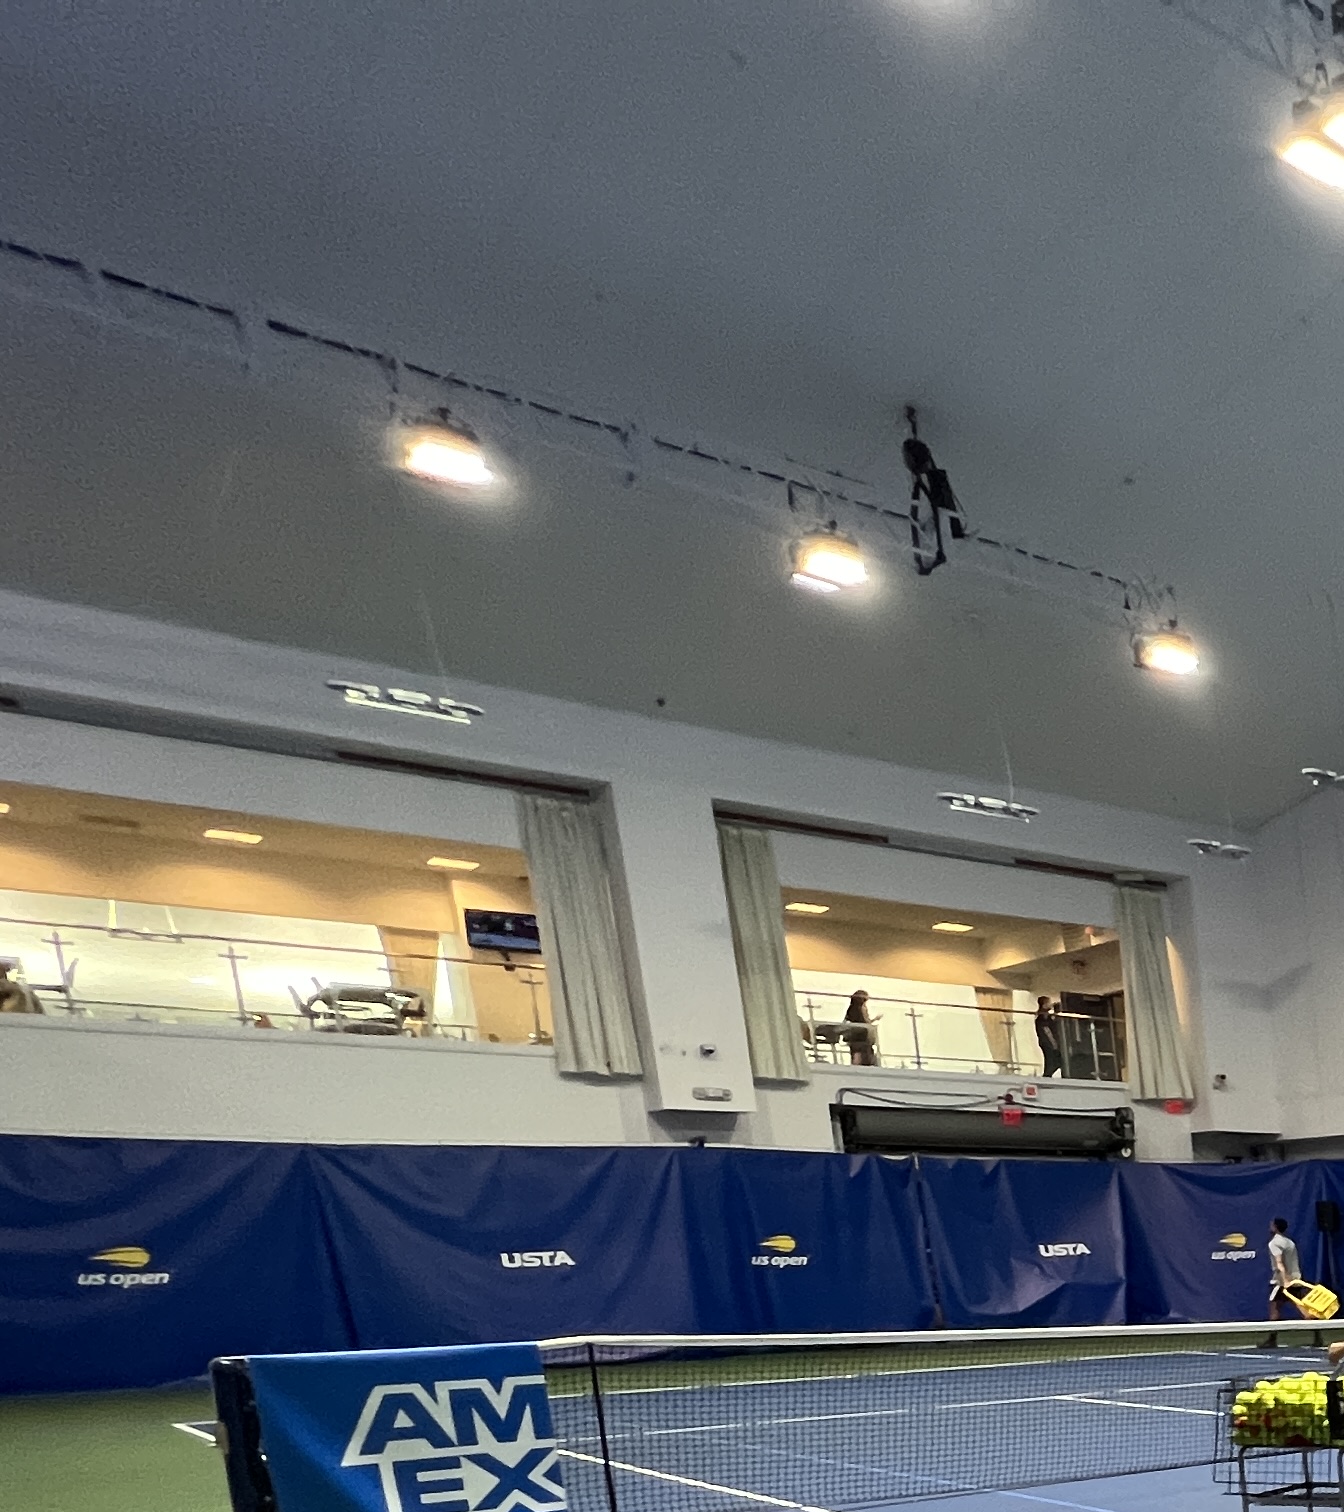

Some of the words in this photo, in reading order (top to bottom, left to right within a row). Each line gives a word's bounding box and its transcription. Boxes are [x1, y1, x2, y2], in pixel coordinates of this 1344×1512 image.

[1038, 1243, 1092, 1257] USTA
[500, 1250, 576, 1268] USTA
[751, 1255, 770, 1266] us
[770, 1256, 808, 1269] open
[77, 1273, 107, 1286] us
[108, 1272, 170, 1289] open
[346, 1377, 557, 1463] AM
